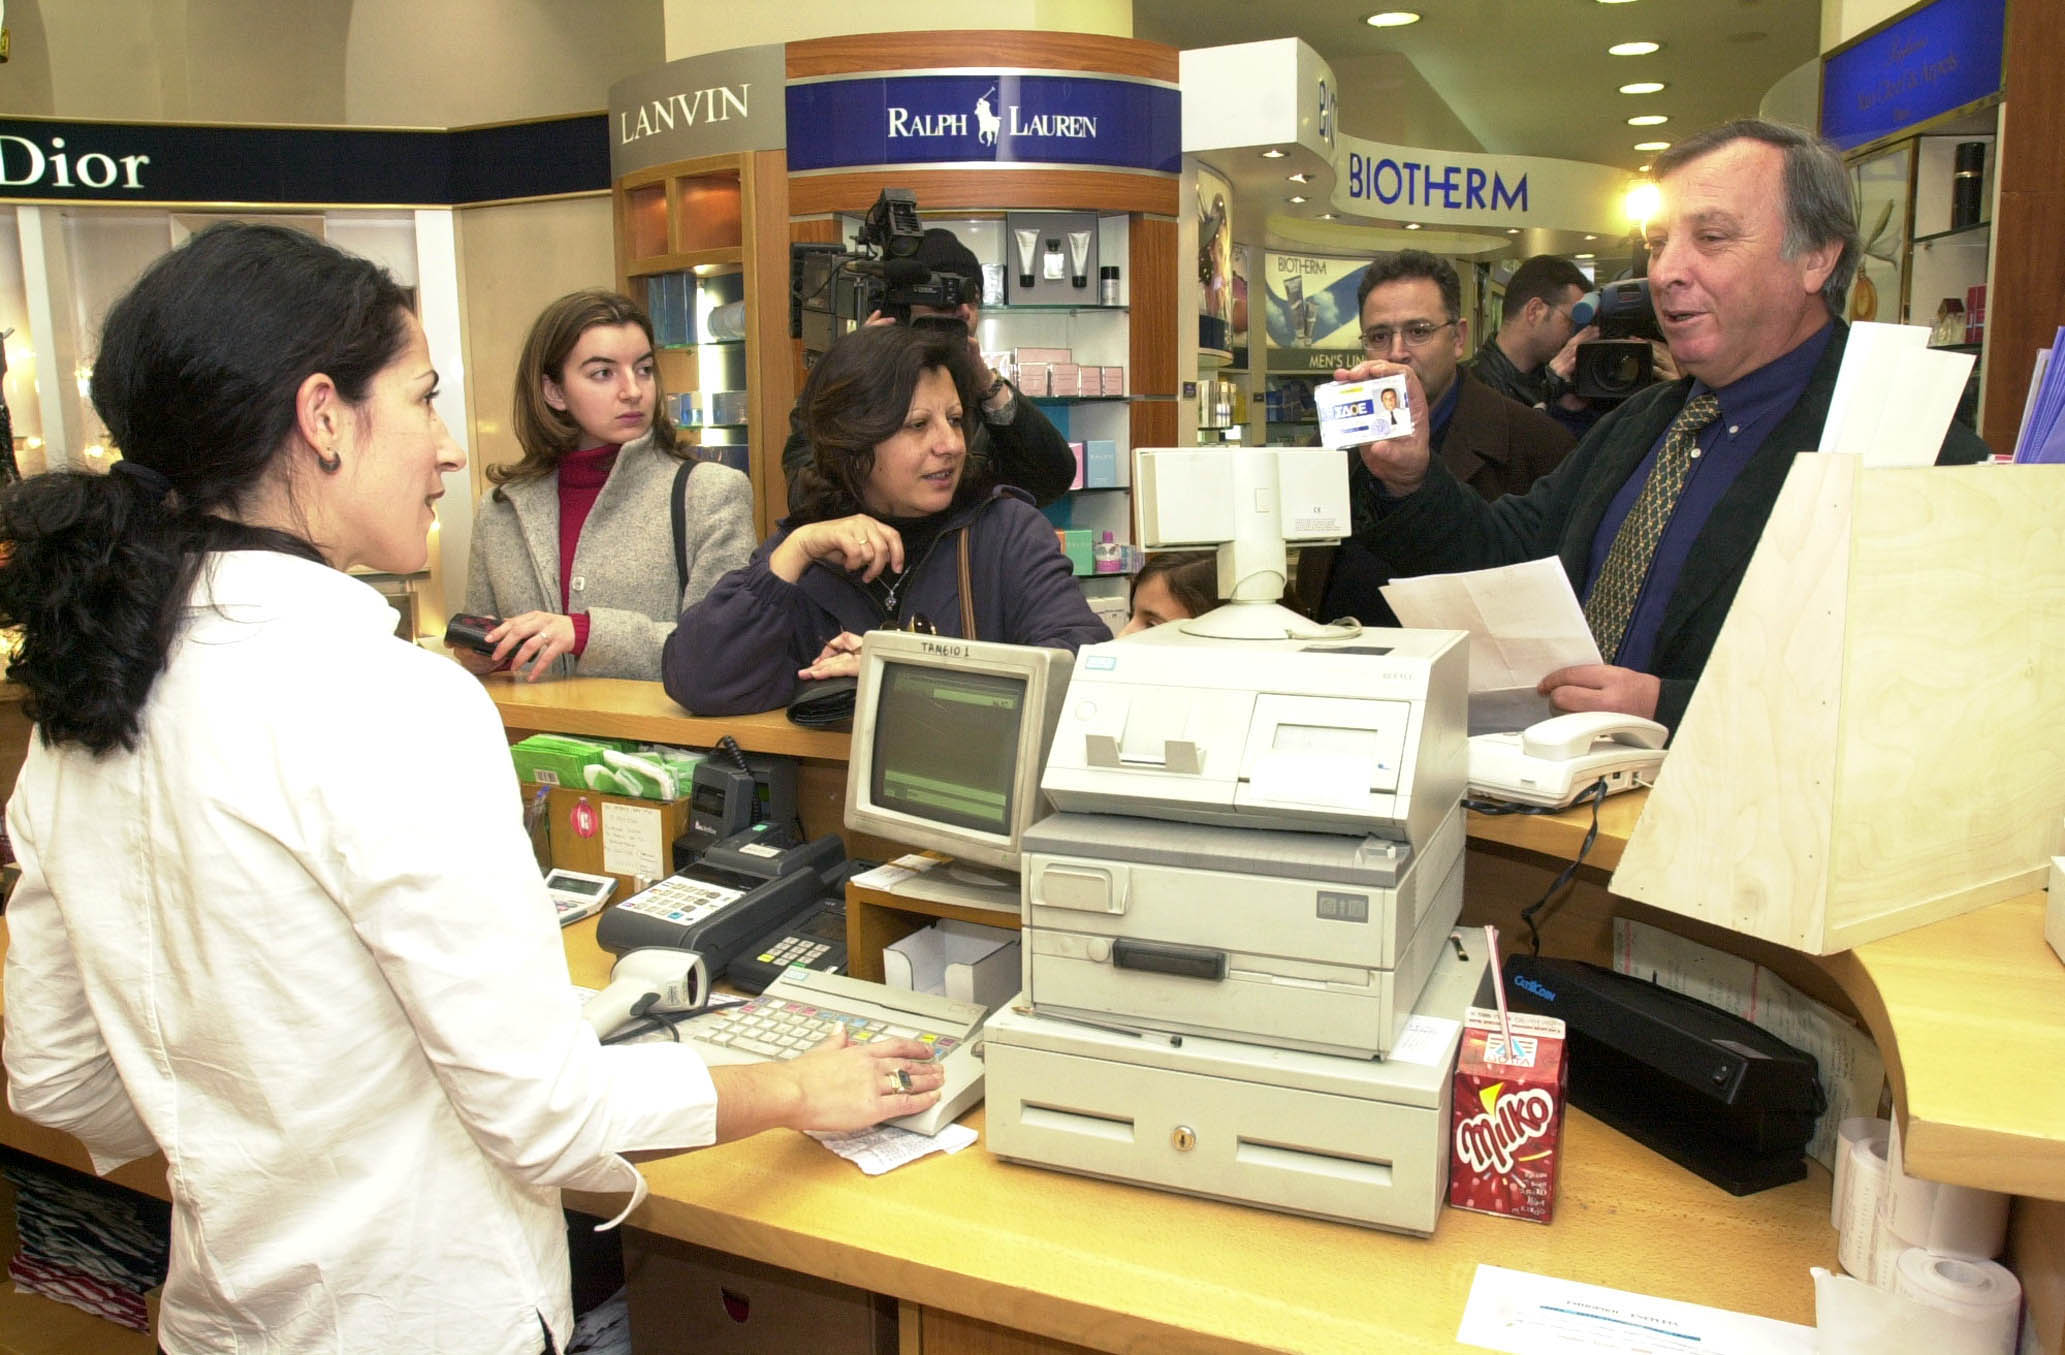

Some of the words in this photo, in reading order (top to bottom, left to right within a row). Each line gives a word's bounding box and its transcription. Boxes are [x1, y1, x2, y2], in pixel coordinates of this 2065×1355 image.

[620, 83, 752, 145] LANVIN
[887, 107, 968, 137] RALPH
[1008, 105, 1097, 138] LAUREN
[0, 135, 150, 188] Dior
[1350, 152, 1528, 212] BIOTHERM
[1277, 256, 1327, 275] BIOTHERM
[1309, 353, 1343, 369] MEN'S
[1346, 353, 1367, 369] LIN
